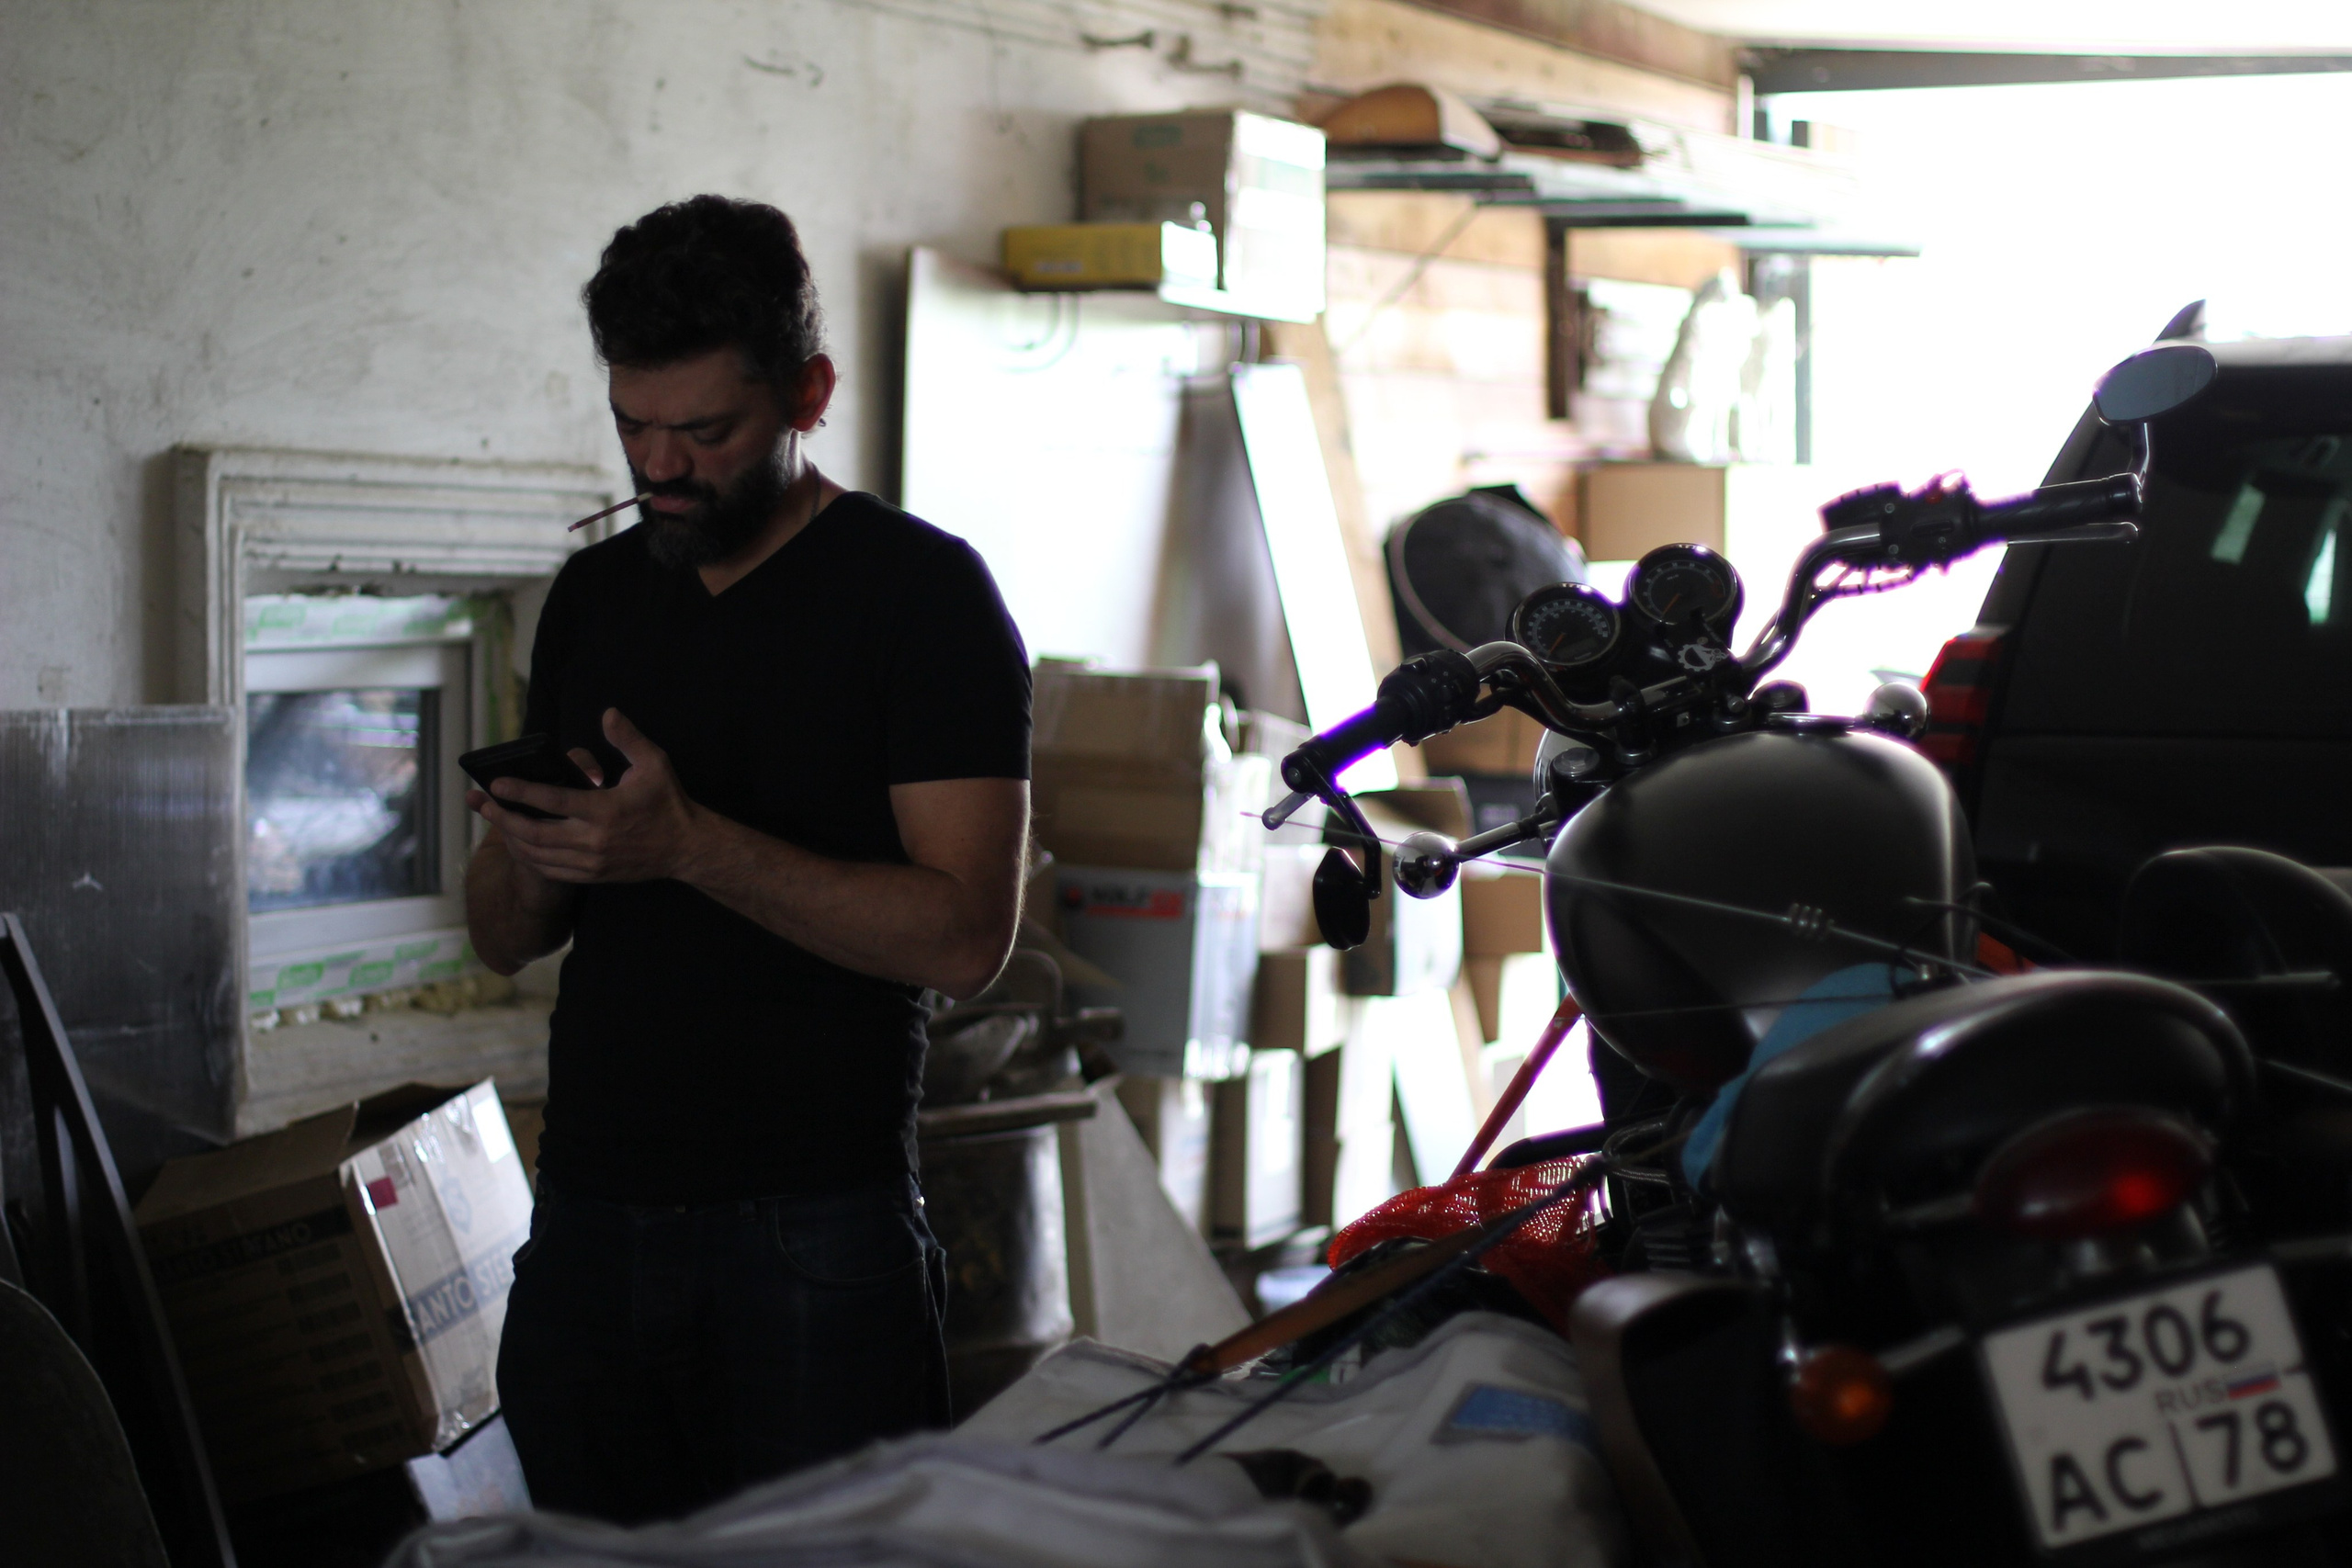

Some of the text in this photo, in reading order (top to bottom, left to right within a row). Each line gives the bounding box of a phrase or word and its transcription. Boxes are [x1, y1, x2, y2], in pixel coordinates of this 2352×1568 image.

[2042, 1291, 2251, 1402] 4306
[2154, 1380, 2228, 1414] RUS
[2048, 1437, 2165, 1533] AC
[2194, 1399, 2311, 1489] 78
